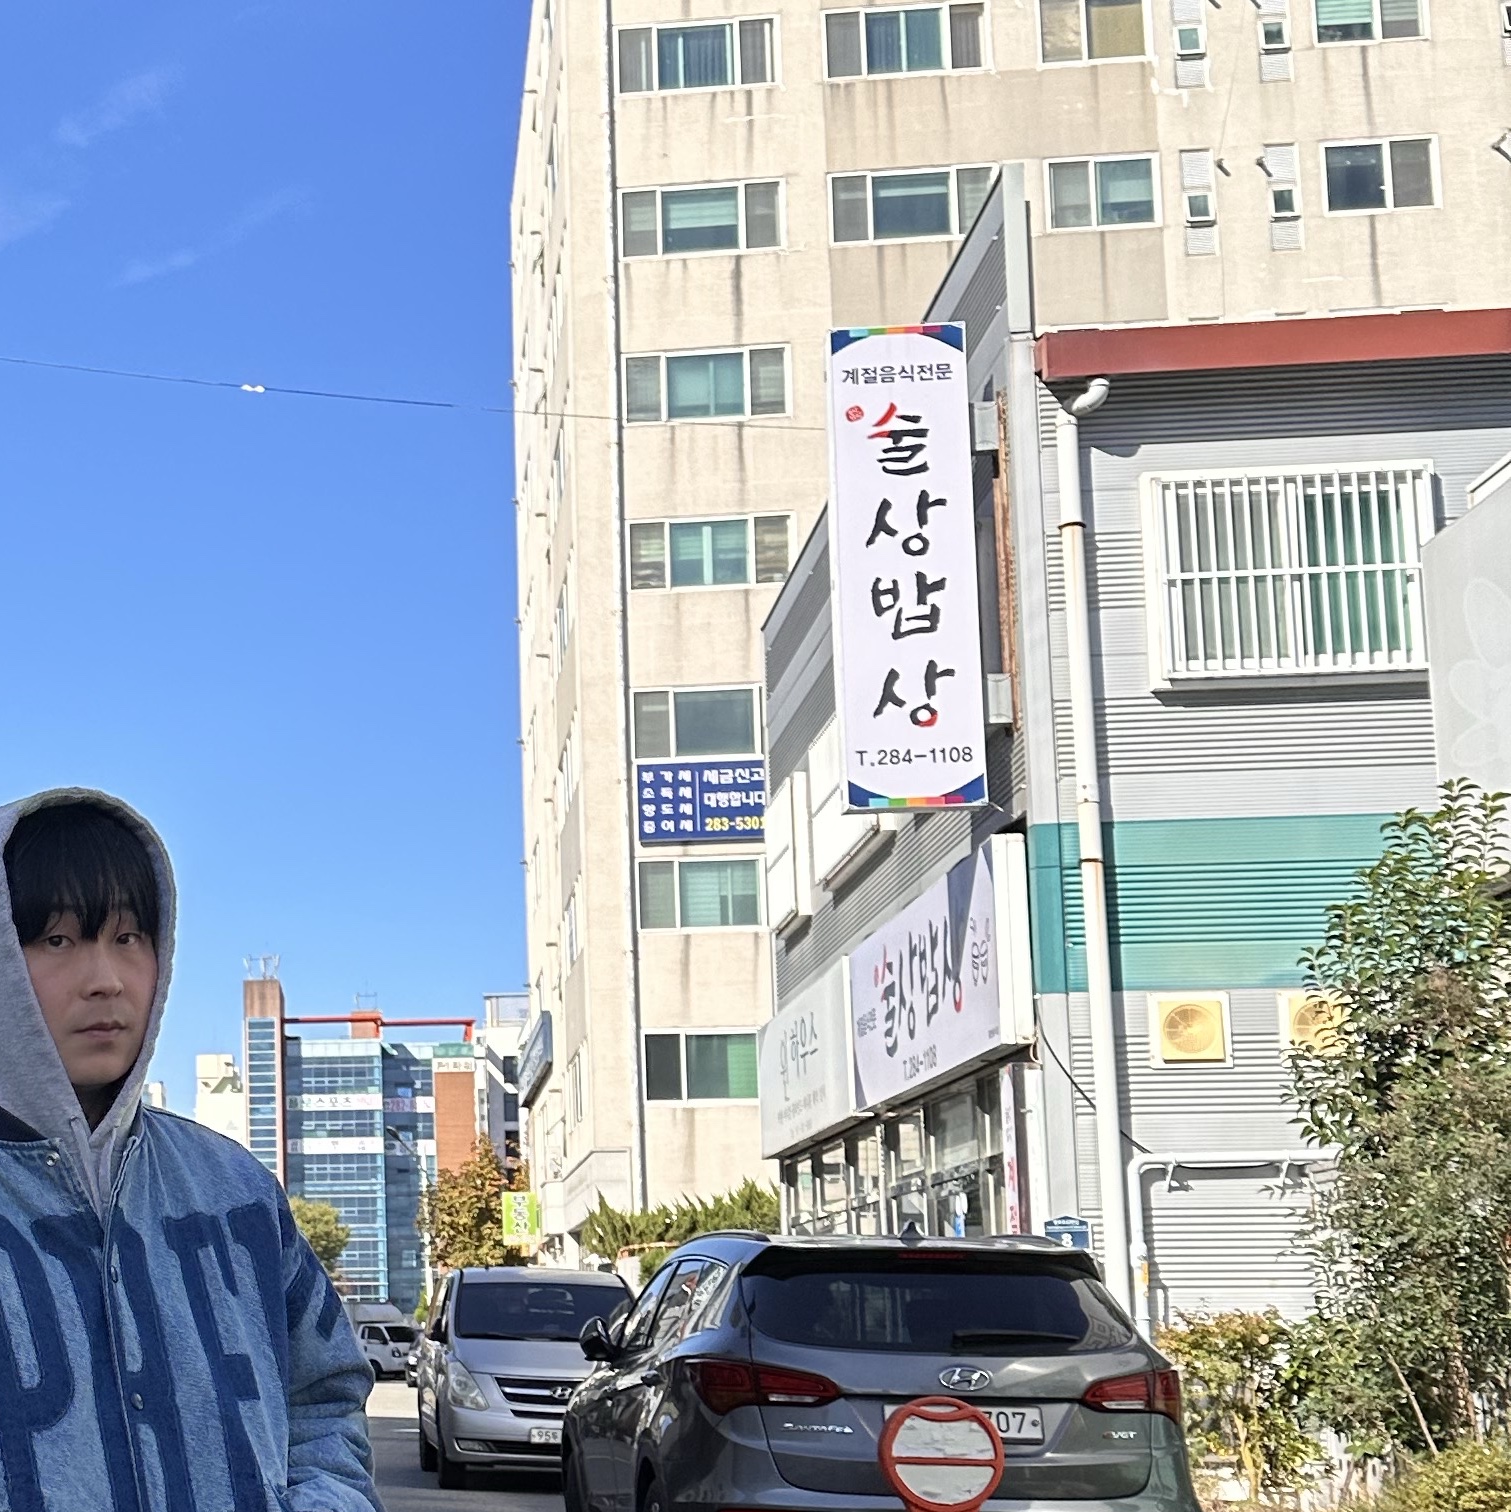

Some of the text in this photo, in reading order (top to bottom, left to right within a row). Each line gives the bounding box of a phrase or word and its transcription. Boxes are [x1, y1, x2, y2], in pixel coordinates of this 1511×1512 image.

[842, 363, 954, 386] 계절음식전문
[866, 402, 956, 729] 술상밥상
[856, 747, 974, 768] T.284-1108
[703, 767, 765, 786] 세금신고
[511, 1195, 529, 1234] 부동산
[1061, 1232, 1074, 1248] 8
